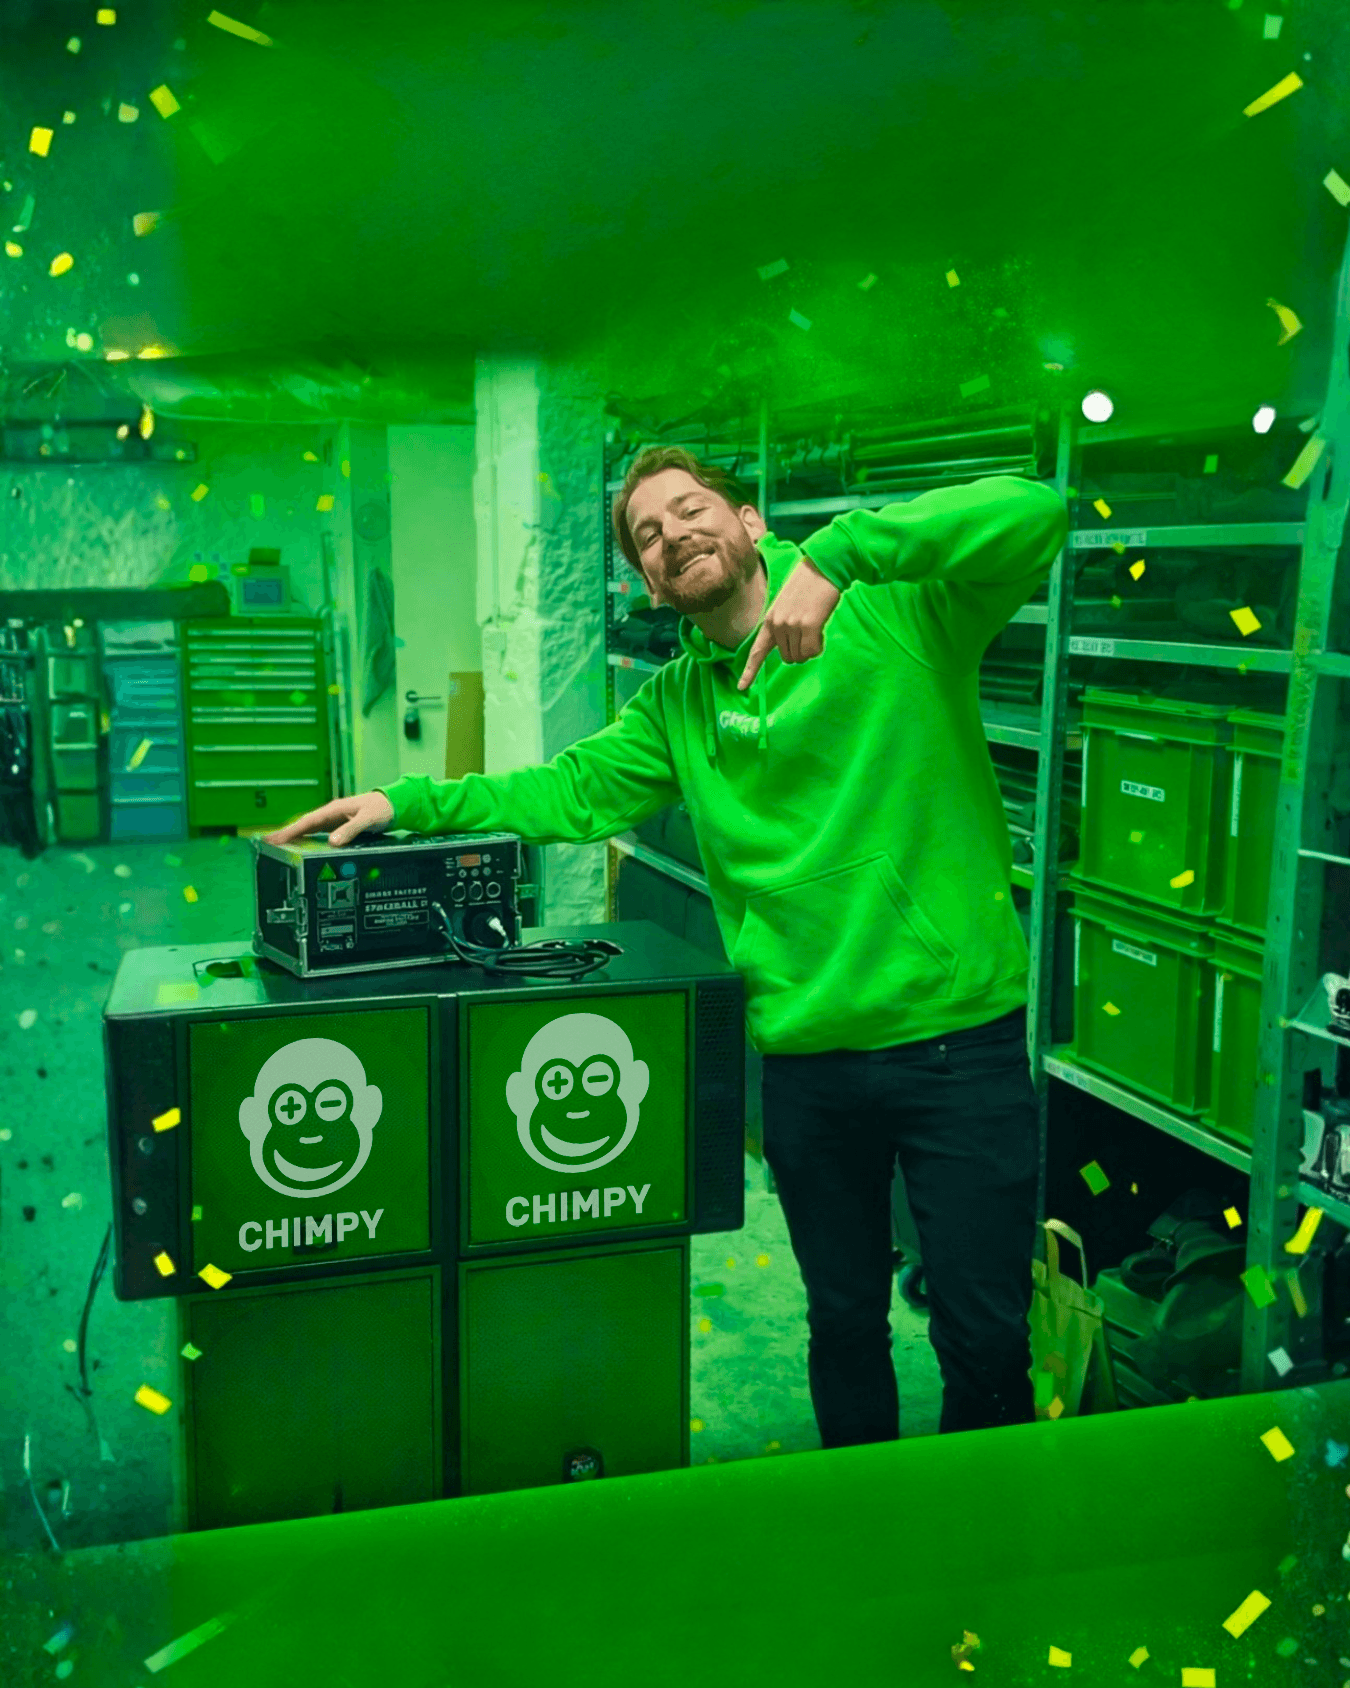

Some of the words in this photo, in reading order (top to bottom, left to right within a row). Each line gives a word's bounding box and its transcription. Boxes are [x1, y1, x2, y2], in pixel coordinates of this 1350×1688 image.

[254, 790, 268, 808] 5
[506, 1184, 651, 1227] CHIMPY
[238, 1209, 385, 1251] CHIMPY
